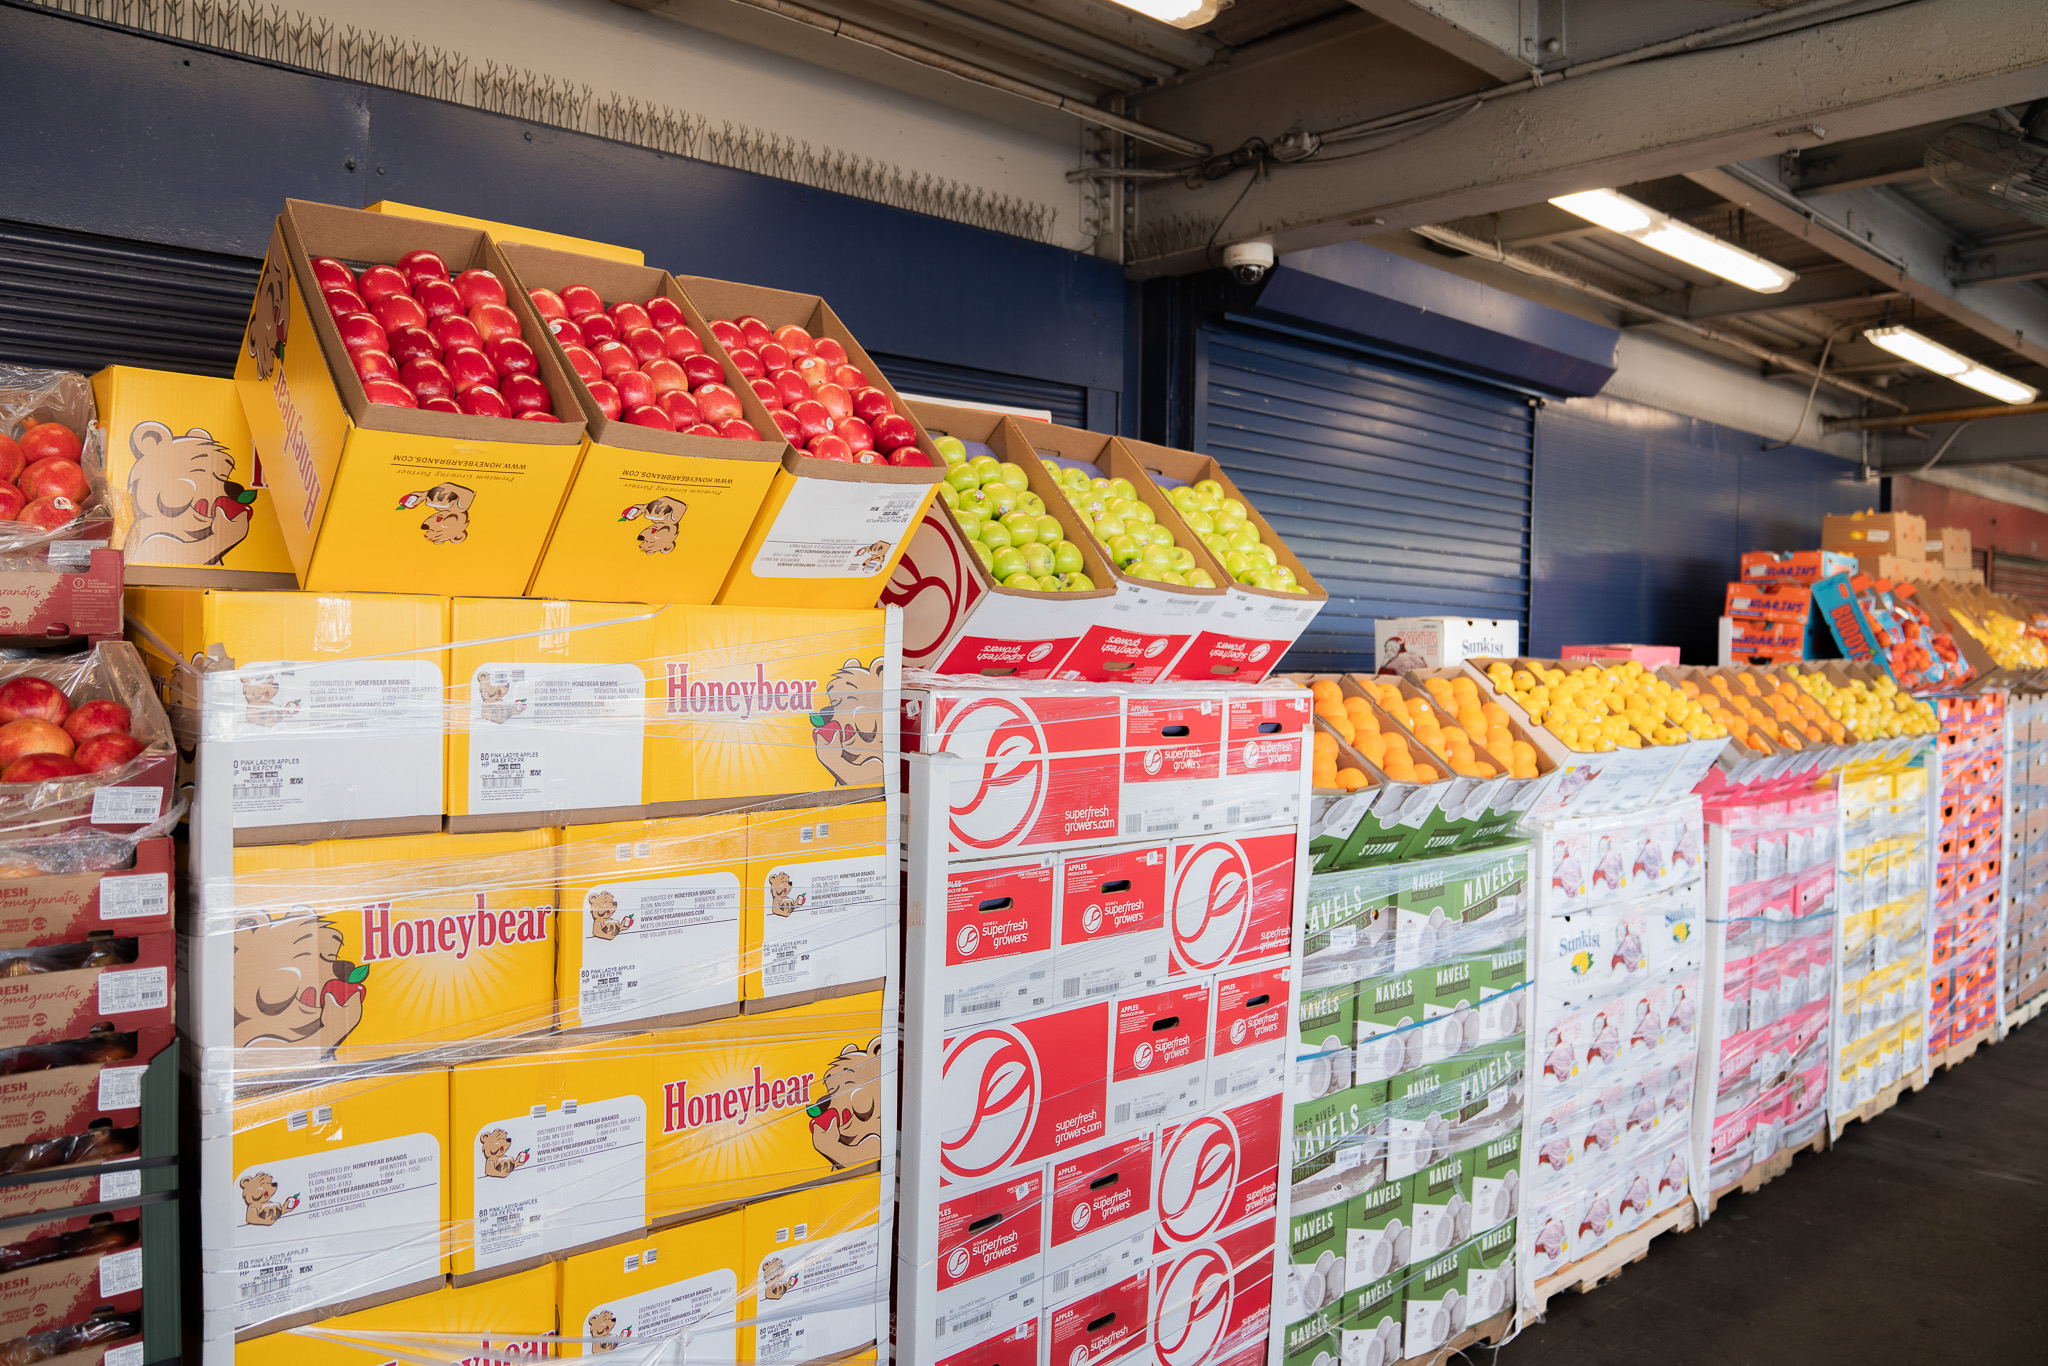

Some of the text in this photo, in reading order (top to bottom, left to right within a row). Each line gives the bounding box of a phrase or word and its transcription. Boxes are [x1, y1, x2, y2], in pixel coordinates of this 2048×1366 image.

[394, 454, 526, 470] WWW.HONEYBEARBRANDS.COM
[476, 474, 515, 482] Premium
[622, 470, 733, 484] WWW.HONEYBEARBRANDS.COM
[1107, 635, 1142, 647] growers
[1397, 631, 1438, 646] SANTA
[1461, 637, 1504, 656] Sunkist
[976, 652, 1026, 663] superfresh
[1101, 643, 1144, 656] superfresh
[1209, 649, 1248, 660] superfresh
[354, 678, 411, 687] HONEYBEAR BRANDS
[665, 662, 818, 722] Honeybear
[1164, 747, 1201, 760] superfresh
[1260, 742, 1293, 755] superfresh
[1173, 759, 1200, 773] growers
[1268, 753, 1292, 765] growers
[1064, 806, 1110, 824] superfresh
[1064, 817, 1115, 837] growers.com
[1358, 842, 1399, 856] NAVELS
[1068, 863, 1087, 872] APPLES
[1412, 871, 1445, 891] NAVELS
[1464, 857, 1516, 907] NAVELS
[1104, 899, 1144, 917] superfresh
[361, 892, 553, 962] Honeybear
[982, 918, 1028, 937] superfresh
[1260, 925, 1291, 941] superfresh
[1558, 929, 1601, 957] Sunkist
[1492, 949, 1523, 970] NAVELS
[581, 970, 589, 978] 80
[1437, 964, 1470, 986] NAVELS
[1220, 983, 1236, 992] APPLES
[1376, 979, 1413, 1003] NAVELS
[1120, 1004, 1139, 1013] APPLES
[1300, 995, 1340, 1021] NAVELS
[1247, 1011, 1279, 1028] superfresh
[1254, 1023, 1279, 1038] growers
[1155, 1034, 1190, 1053] superfresh
[1164, 1046, 1190, 1063] growers
[1461, 1051, 1513, 1104] NAVELS
[662, 1065, 815, 1134] Honeybear
[537, 1117, 600, 1136] DISTRIBUTED HONEYBEAR
[1055, 1109, 1098, 1133] superfresh
[1055, 1120, 1102, 1146] growers.com
[537, 1136, 607, 1156] WWW.HONEYBEARBRANDS.COM
[1488, 1136, 1518, 1160] NAVELS
[309, 1166, 342, 1179] DISTRIBUTED
[352, 1158, 384, 1170] HONEYBEAR
[386, 1154, 408, 1164] BRANDS
[1058, 1165, 1077, 1177] APPLES
[1429, 1160, 1462, 1185] NAVELS
[309, 1178, 393, 1201] WWW.HONEYBEARBRANDS.COM
[309, 1199, 327, 1209] MEETS
[337, 1193, 360, 1203] EXCEEDS
[372, 1186, 388, 1195] EXTRA
[389, 1183, 405, 1192] FANCY
[1093, 1187, 1131, 1211] superfresh
[1246, 1181, 1276, 1201] superfresh
[1365, 1182, 1402, 1210] NAVELS
[309, 1202, 366, 1220] ONE VOLUME BUSHEL
[479, 1209, 488, 1217] 80
[1102, 1200, 1131, 1220] growers
[1294, 1212, 1334, 1243] NAVELS
[972, 1230, 1018, 1256] superfresh
[1482, 1225, 1512, 1251] NAVELS
[238, 1261, 248, 1269] 80
[287, 1248, 309, 1257] APPLES
[1425, 1254, 1459, 1282] NAVELS
[1358, 1280, 1393, 1310] NAVELS
[1055, 1310, 1074, 1323] APPLES
[1090, 1325, 1129, 1353] superfresh
